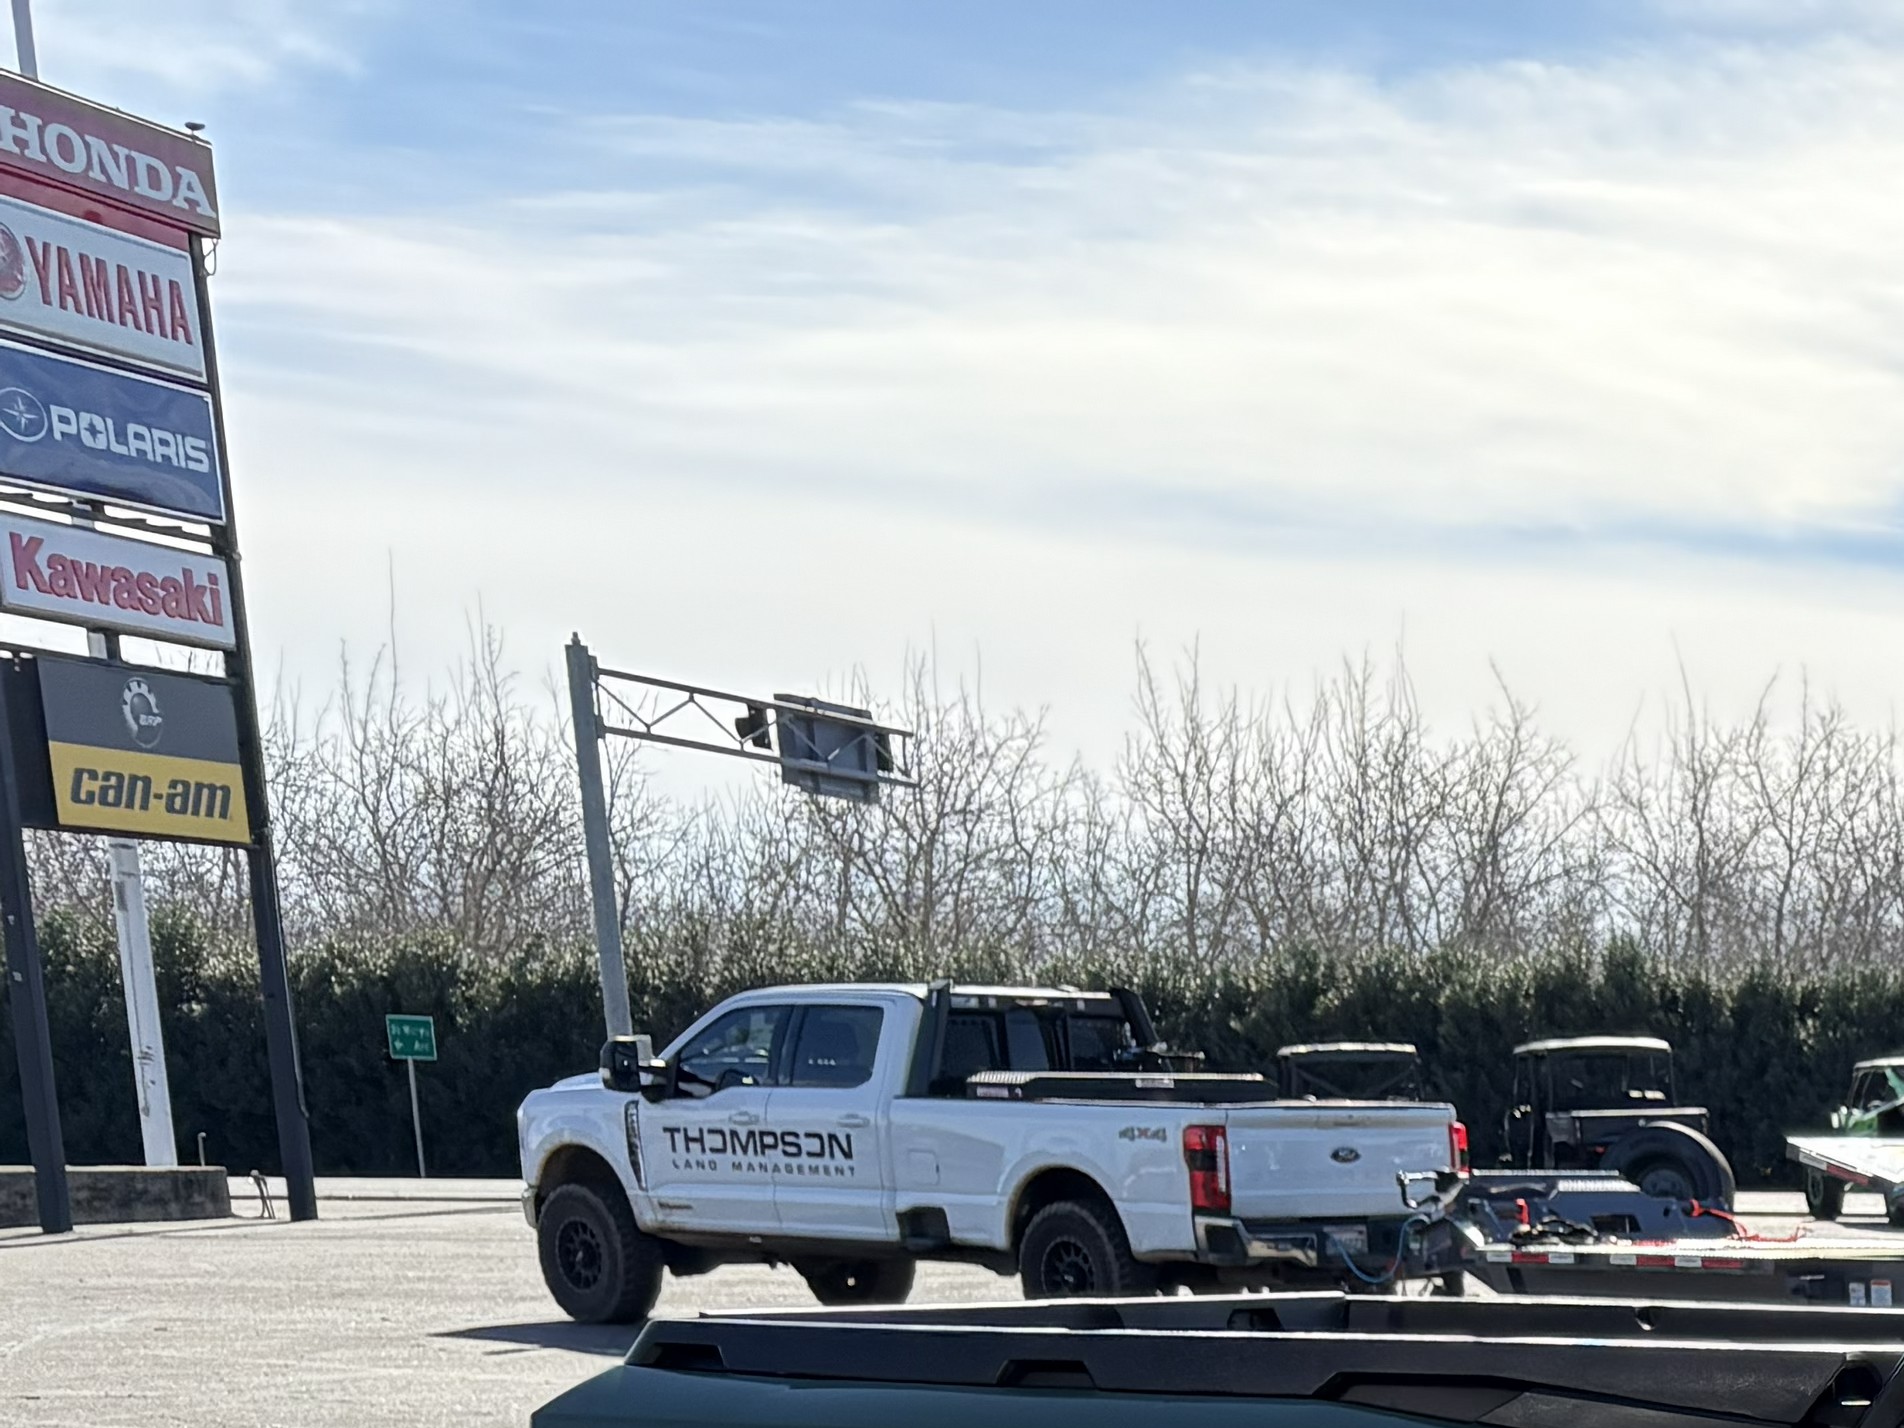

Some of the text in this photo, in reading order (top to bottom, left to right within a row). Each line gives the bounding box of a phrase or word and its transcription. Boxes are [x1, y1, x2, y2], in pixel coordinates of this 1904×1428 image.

[0, 104, 216, 219] HONDA
[25, 236, 193, 346] YAMAHA
[50, 404, 210, 473] POLARIS
[9, 532, 224, 627] Kawasaki
[70, 767, 232, 820] can-am
[662, 1126, 855, 1160] THOMPSON
[672, 1158, 856, 1177] LAND MANAGEMENT
